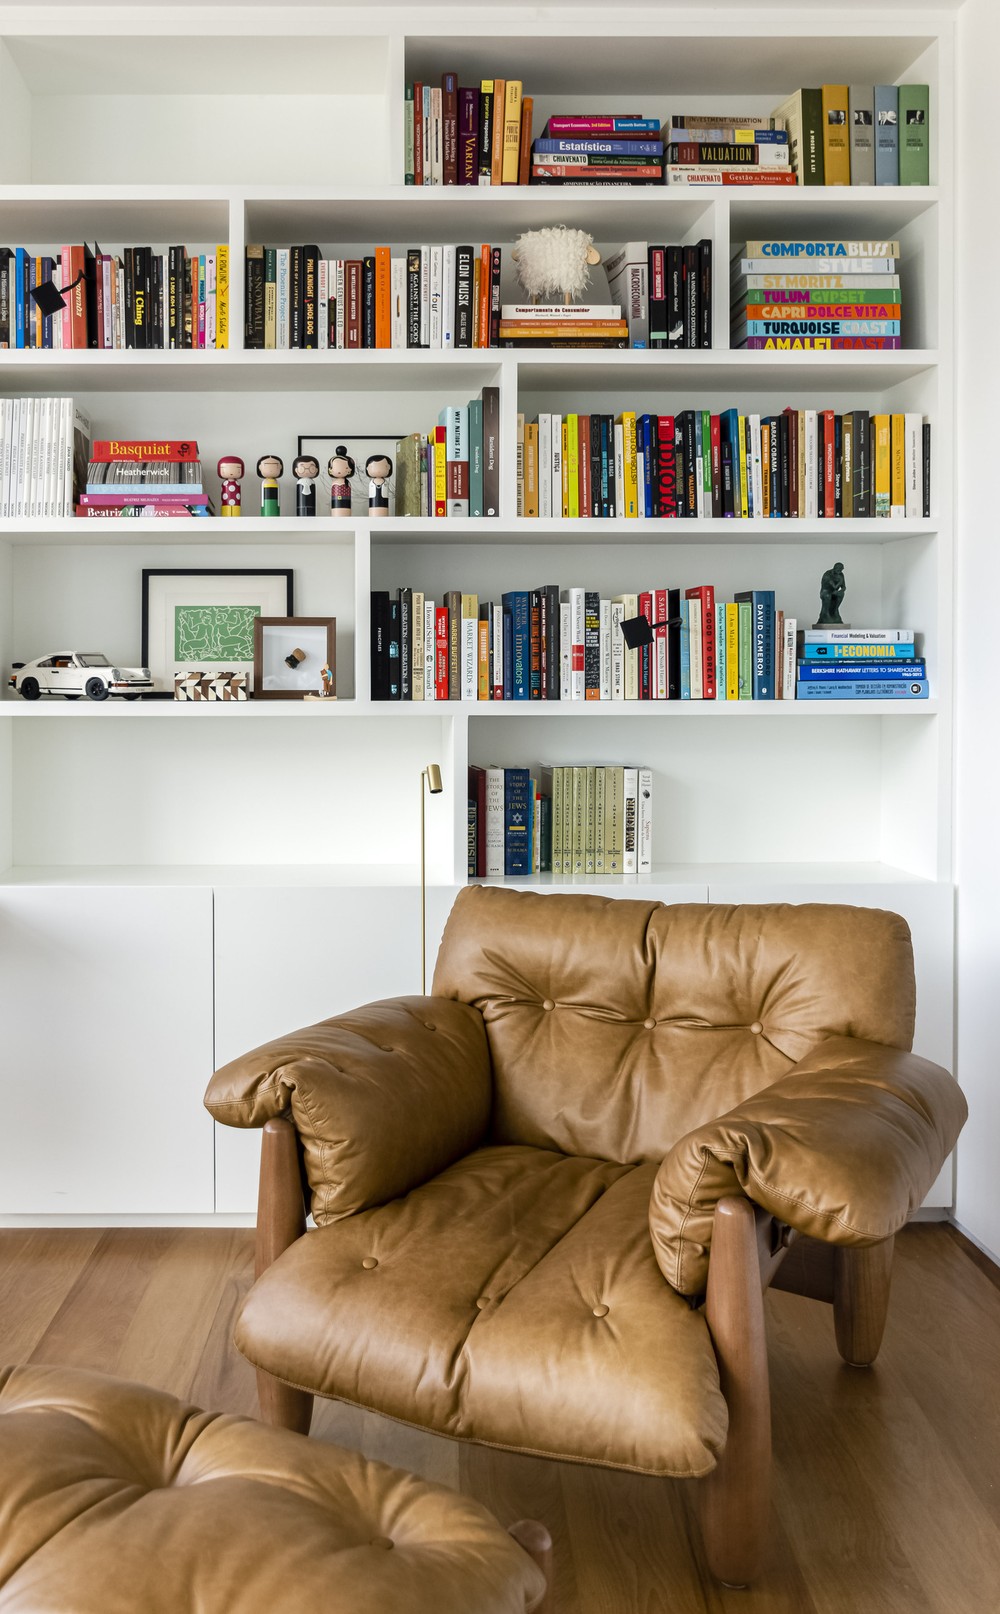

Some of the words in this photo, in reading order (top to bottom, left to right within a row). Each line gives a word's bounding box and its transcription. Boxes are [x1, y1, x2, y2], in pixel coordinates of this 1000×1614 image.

[560, 142, 612, 151] Estatística
[466, 138, 476, 178] VARIAN
[702, 148, 752, 161] VALUATION
[762, 243, 847, 256] COMPORTA
[848, 243, 889, 256] BLISS
[459, 254, 470, 277] ELON
[819, 258, 873, 272] STYLE
[458, 281, 470, 306] MUSK
[631, 268, 640, 319] MACROECONOMIA
[763, 291, 810, 303] TULUM
[811, 291, 866, 303] GYPSET
[135, 297, 144, 325] Ching
[691, 308, 696, 316] DO
[762, 307, 806, 318] CAPRI
[807, 306, 852, 317] DOLCE
[855, 306, 888, 317] VITA
[764, 322, 840, 334] TURQUOISE
[842, 322, 887, 334] COAST
[764, 338, 831, 349] AMALFI
[834, 338, 886, 349] COAST
[109, 442, 171, 458] Basquiat
[631, 444, 636, 454] DO
[116, 468, 170, 476] Heatherwick
[658, 438, 675, 516] IDIOTA
[88, 508, 123, 517] Beatriz
[125, 508, 169, 517] Milhazes
[730, 618, 734, 627] Am
[707, 641, 712, 652] TO
[834, 645, 896, 657] I-ECONOMIA
[516, 634, 524, 684] innovators
